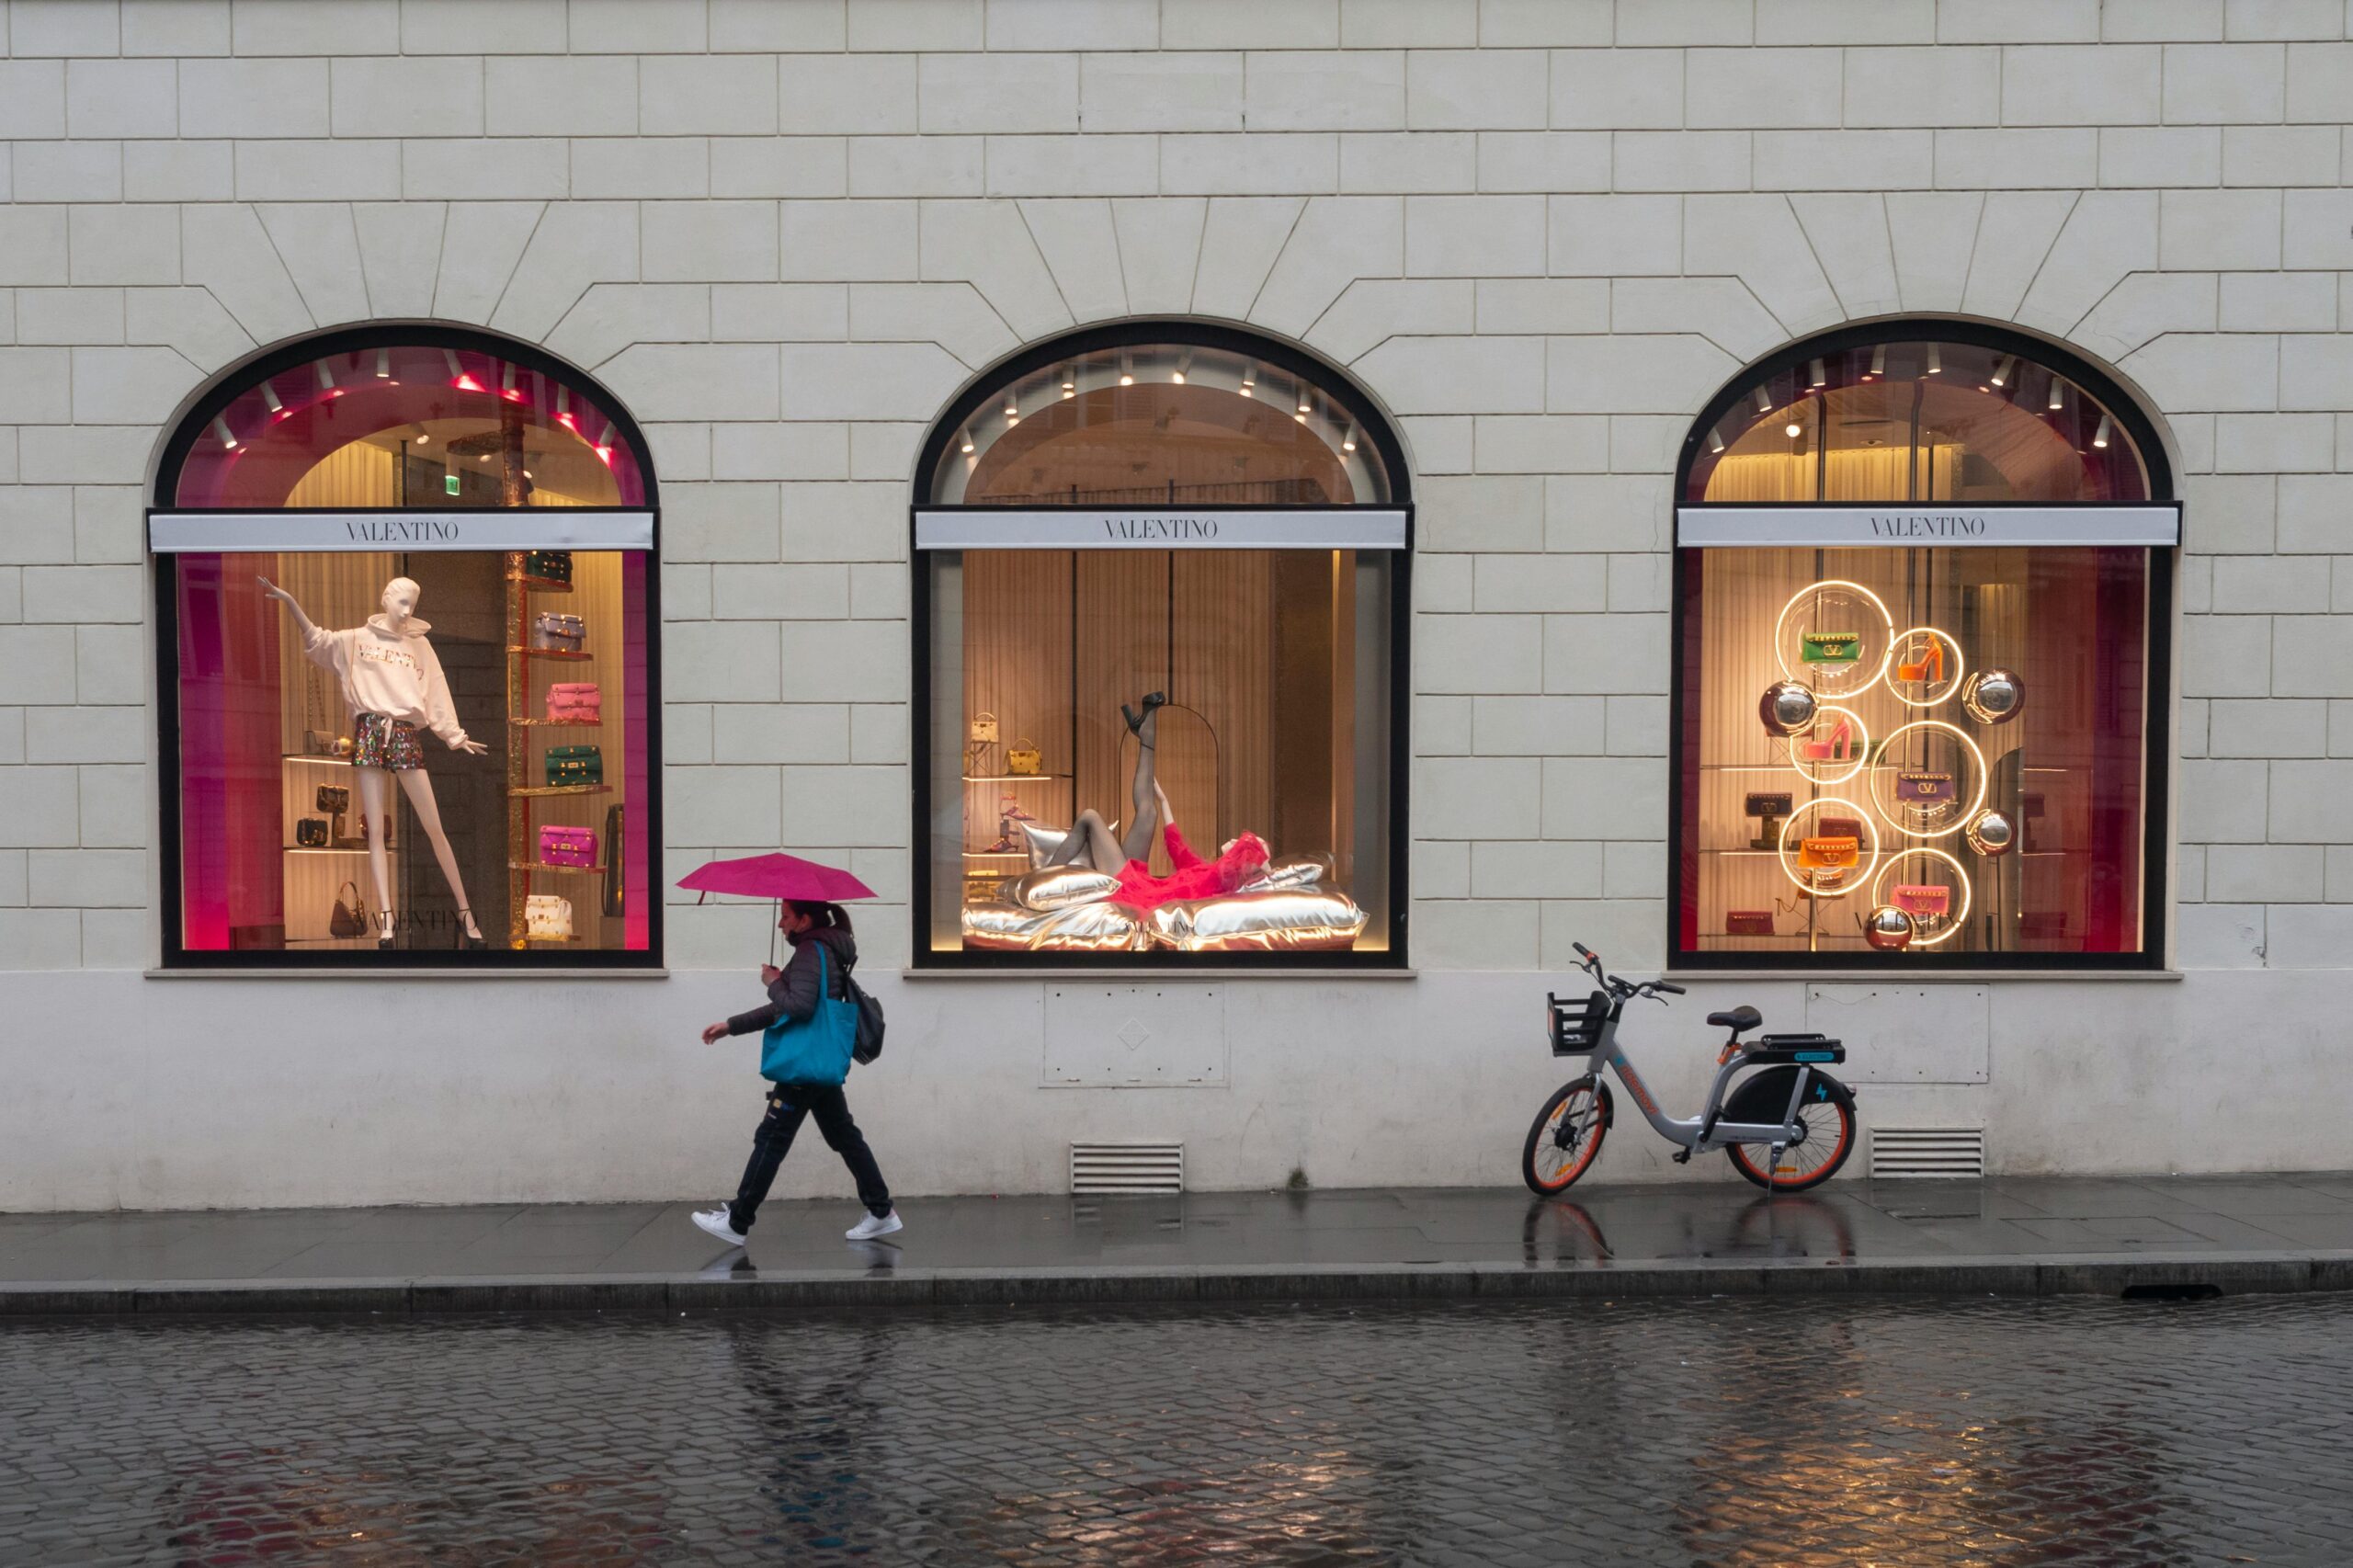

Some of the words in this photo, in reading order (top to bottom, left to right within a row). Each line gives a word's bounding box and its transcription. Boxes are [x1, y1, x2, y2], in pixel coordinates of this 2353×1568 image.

[346, 522, 459, 541] VALENTINO
[1105, 519, 1219, 539] VALENTINO
[1870, 517, 1985, 537] VALENTINO
[358, 644, 425, 681] VALENTIO
[354, 909, 479, 931] VALENTINO
[1124, 921, 1196, 934] VALETINO
